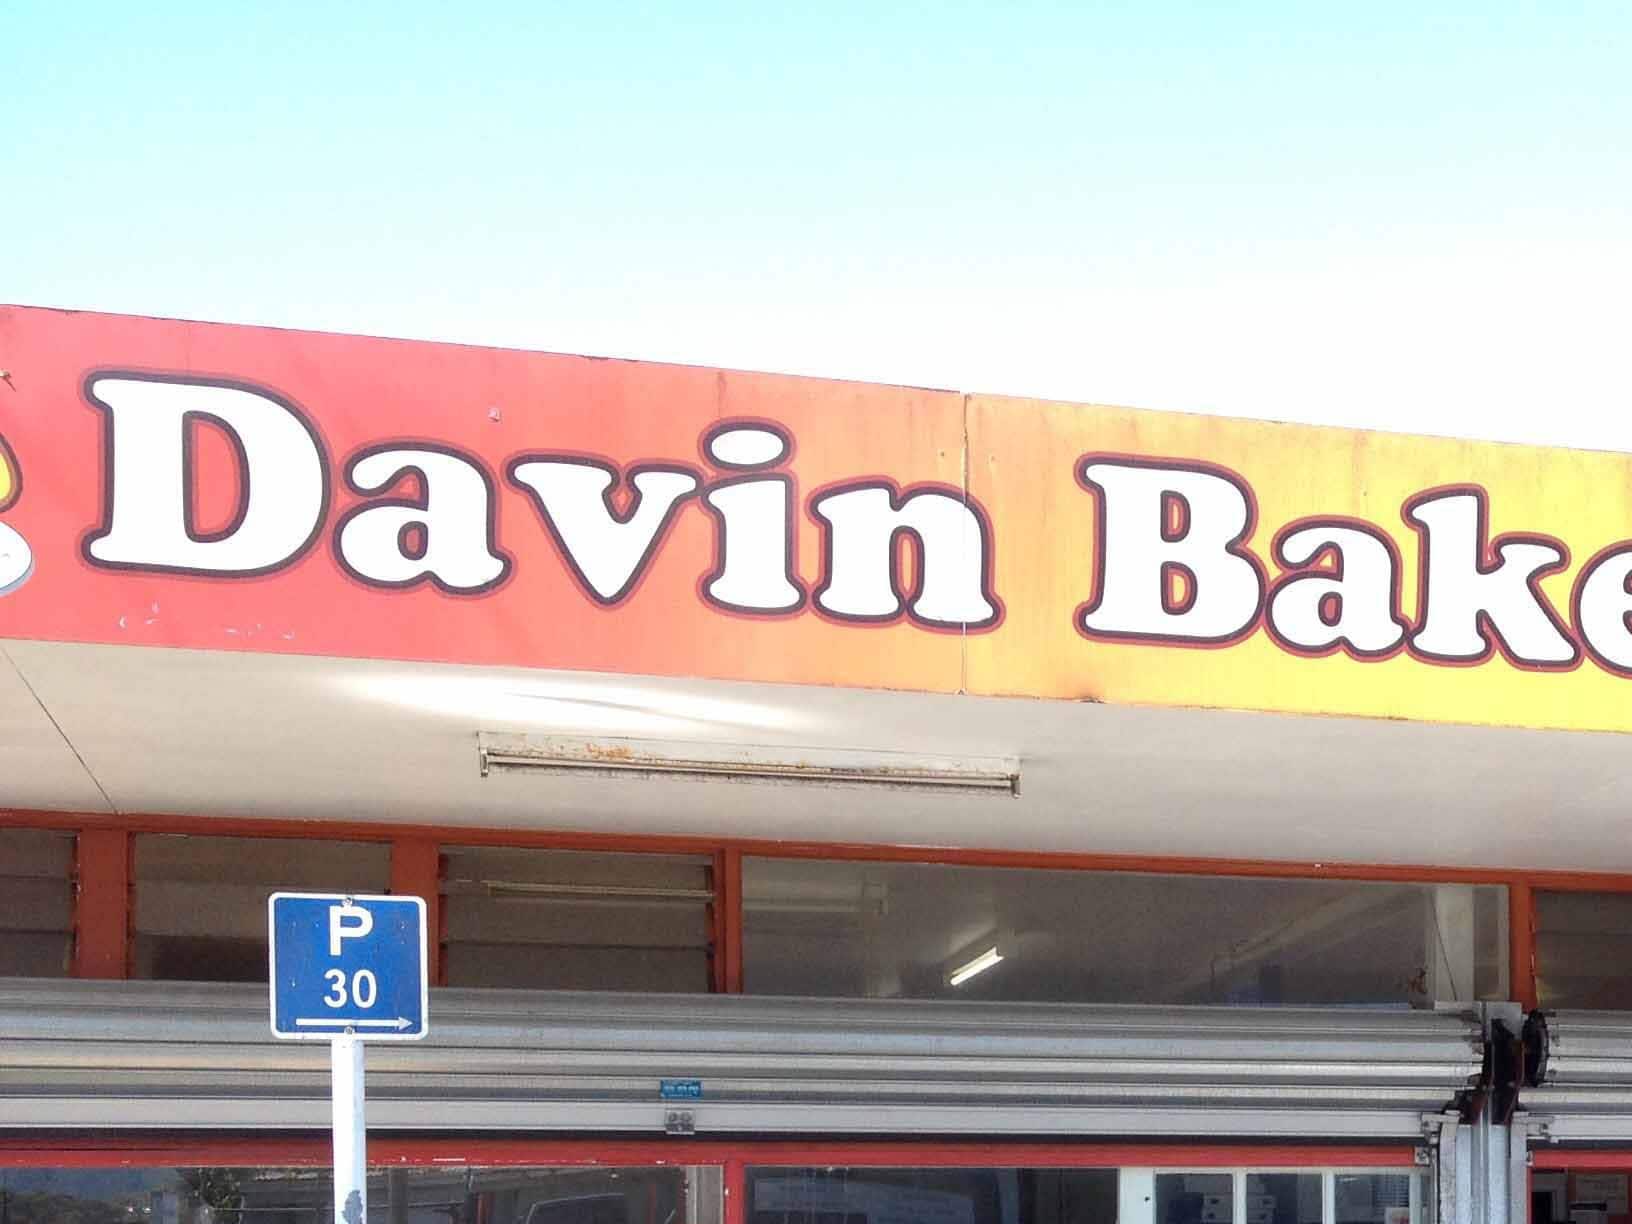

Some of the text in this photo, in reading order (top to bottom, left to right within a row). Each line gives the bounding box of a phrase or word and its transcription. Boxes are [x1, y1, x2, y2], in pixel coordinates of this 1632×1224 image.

[82, 366, 1001, 632] Davin
[329, 905, 373, 956] P
[324, 968, 377, 1008] 30
